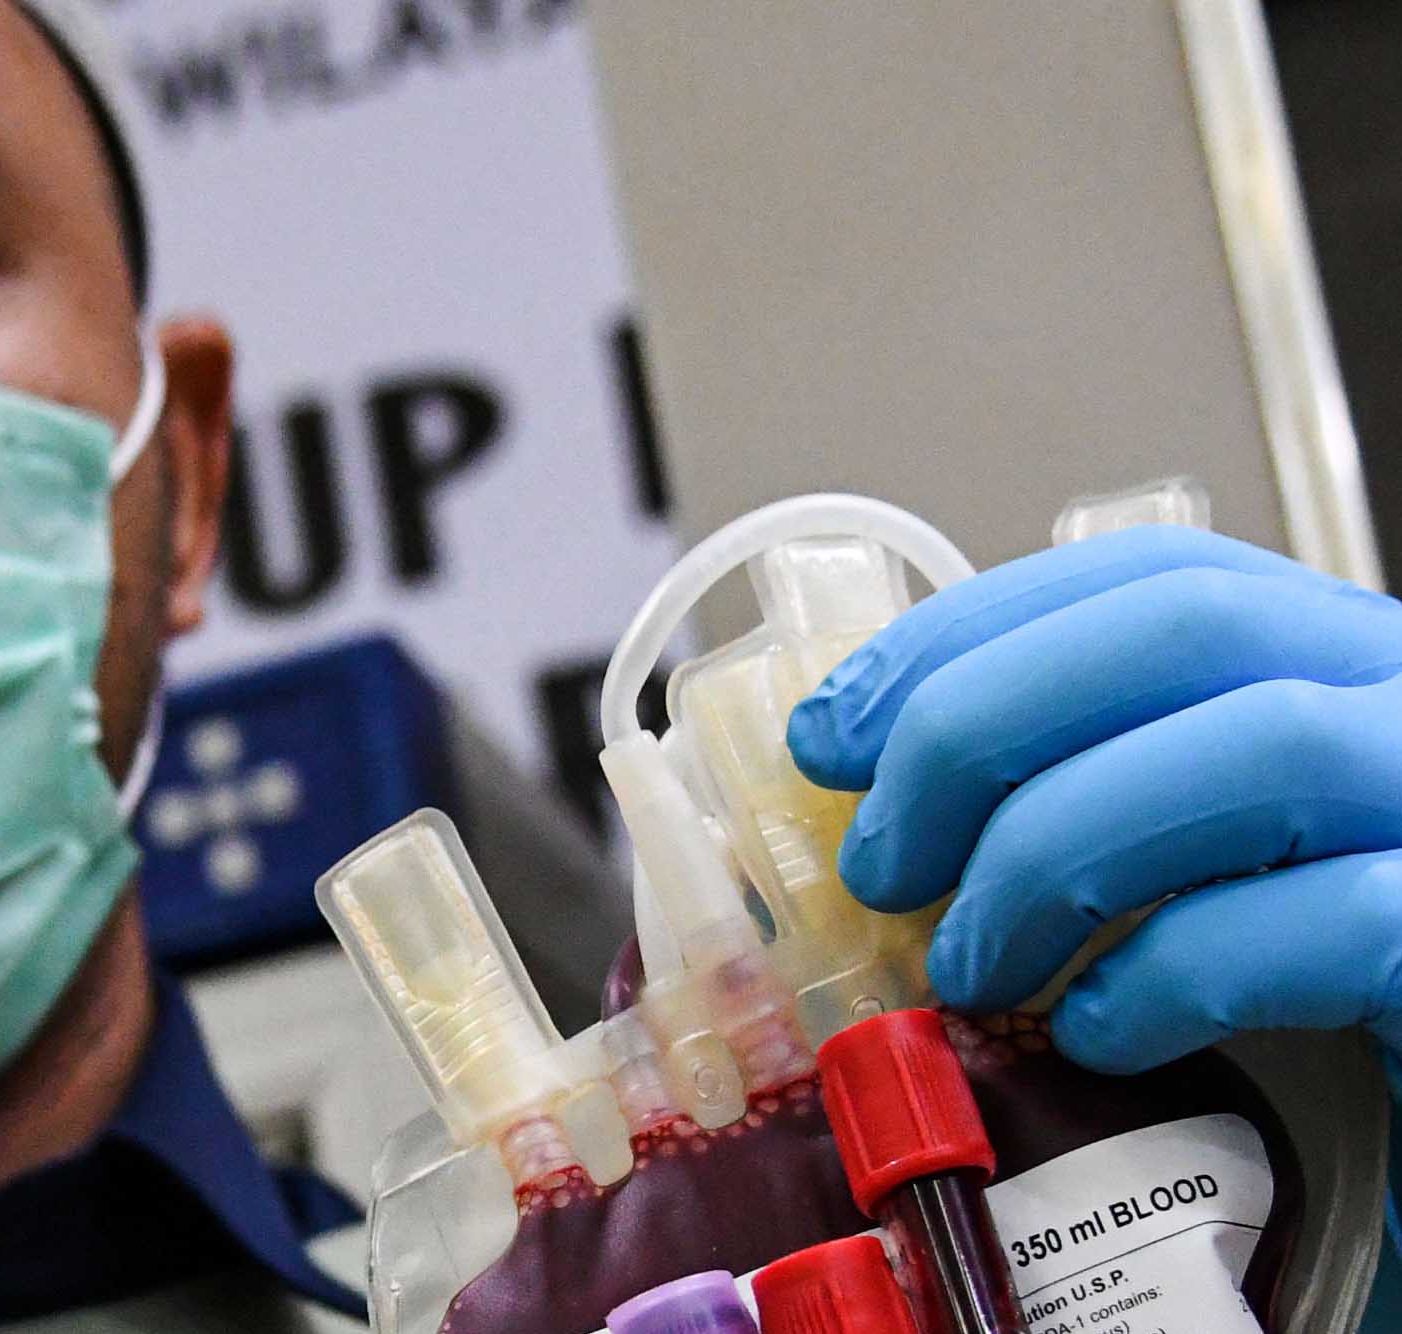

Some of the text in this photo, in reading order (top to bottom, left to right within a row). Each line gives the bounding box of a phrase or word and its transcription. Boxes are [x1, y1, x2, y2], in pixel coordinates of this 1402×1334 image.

[1011, 1174, 1219, 1268] 350 ml BLOOD
[1071, 1269, 1129, 1302] U.S.P.
[1089, 1284, 1164, 1324] contains:
